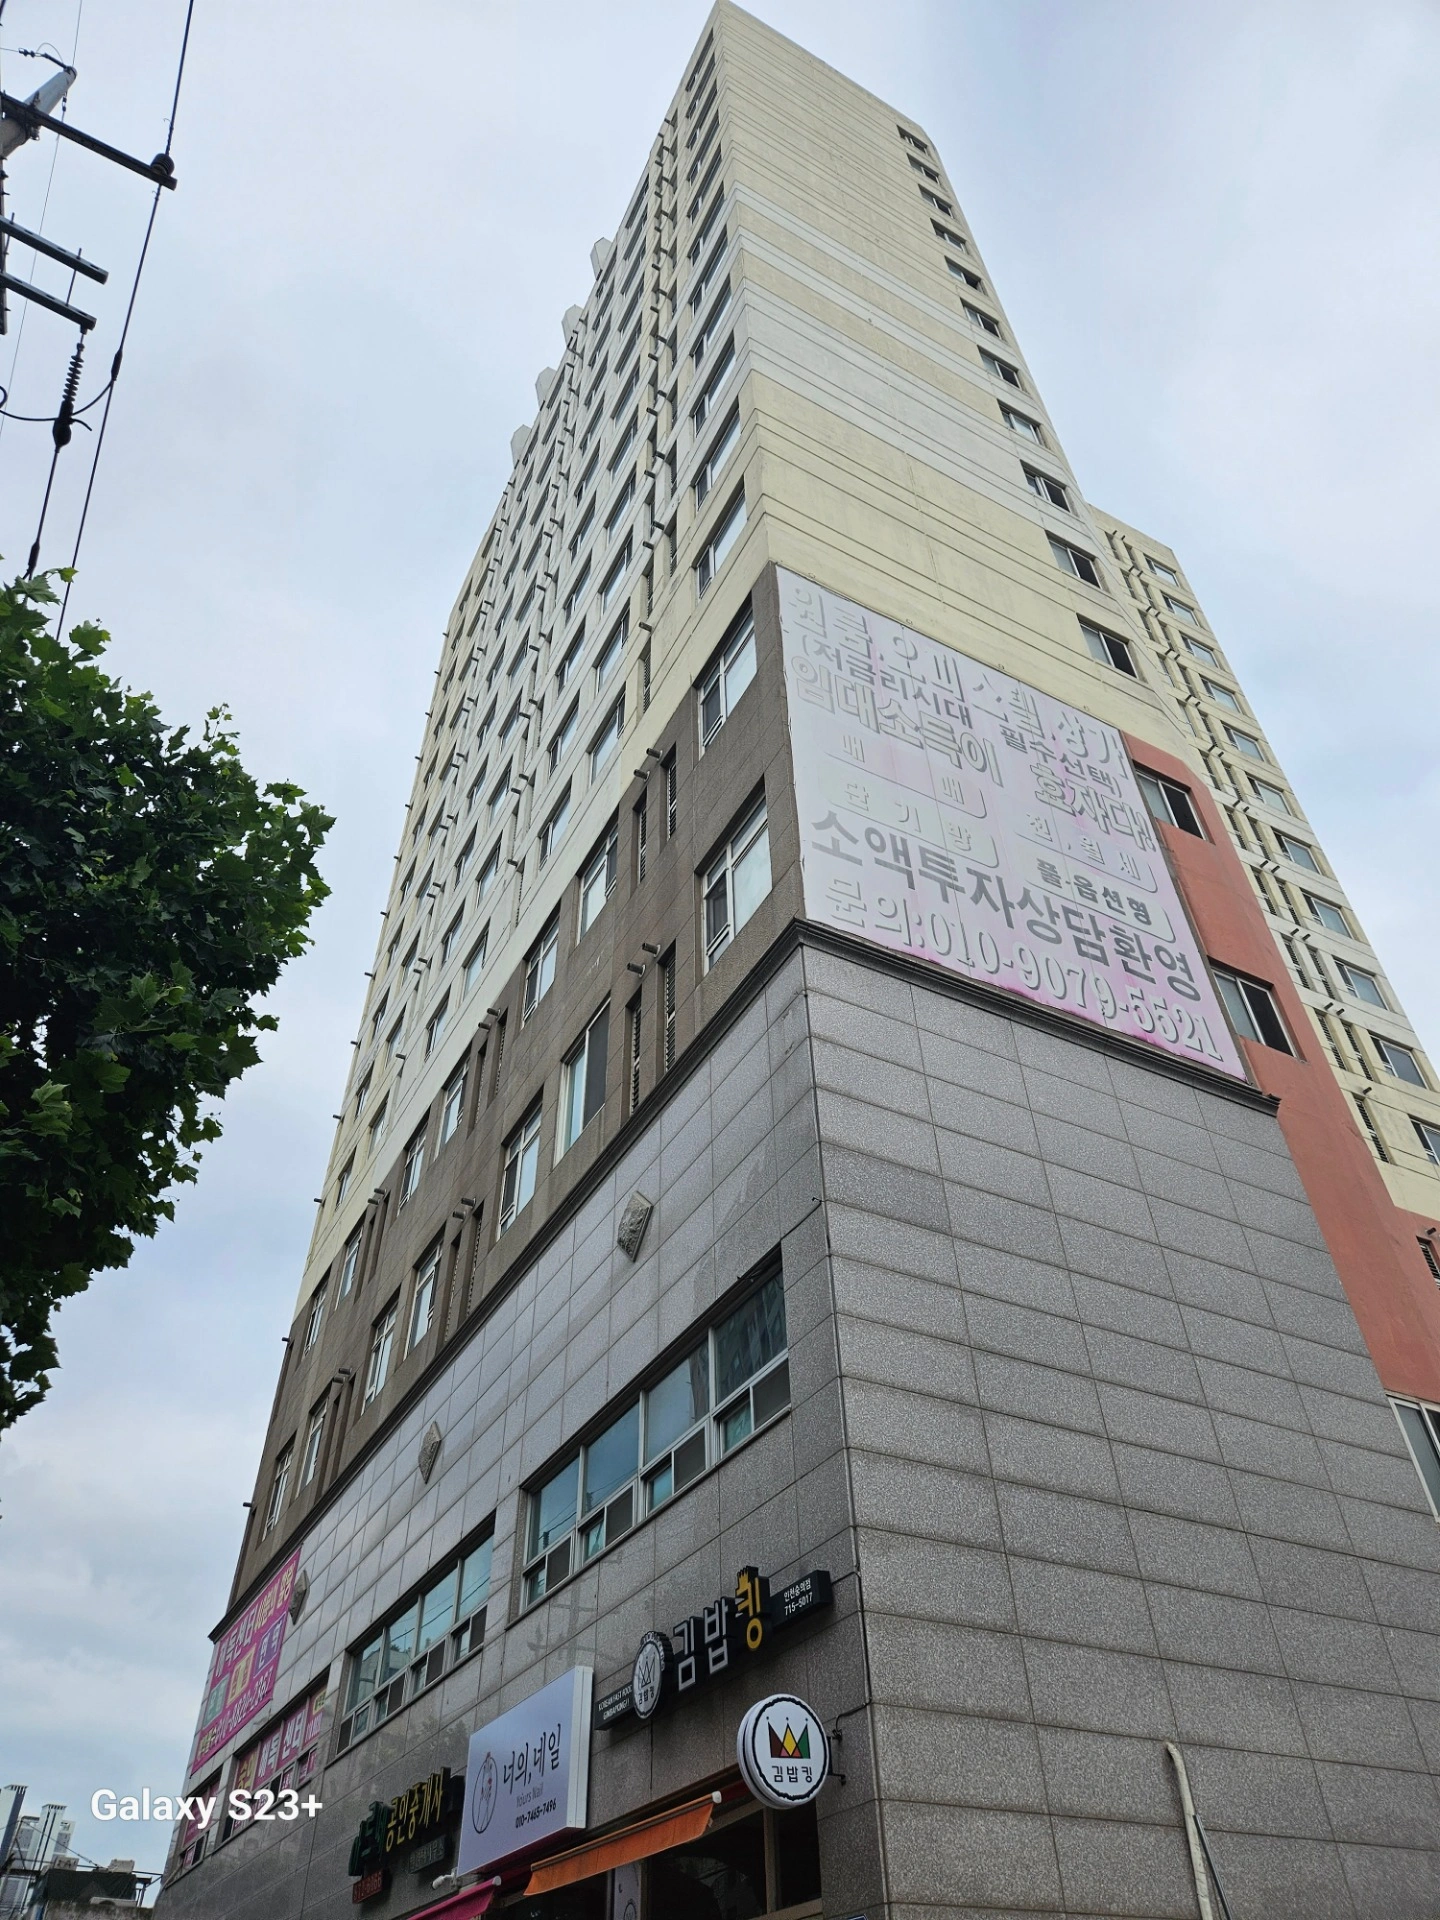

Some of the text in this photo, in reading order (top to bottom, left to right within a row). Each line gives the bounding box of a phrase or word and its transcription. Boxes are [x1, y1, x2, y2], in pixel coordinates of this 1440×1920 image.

[790, 655, 1004, 787] 임대소득이
[811, 809, 1201, 1001] 소액투자상담환영
[386, 1768, 444, 1853] 공인중개사
[772, 1765, 813, 1783] 김밥킹
